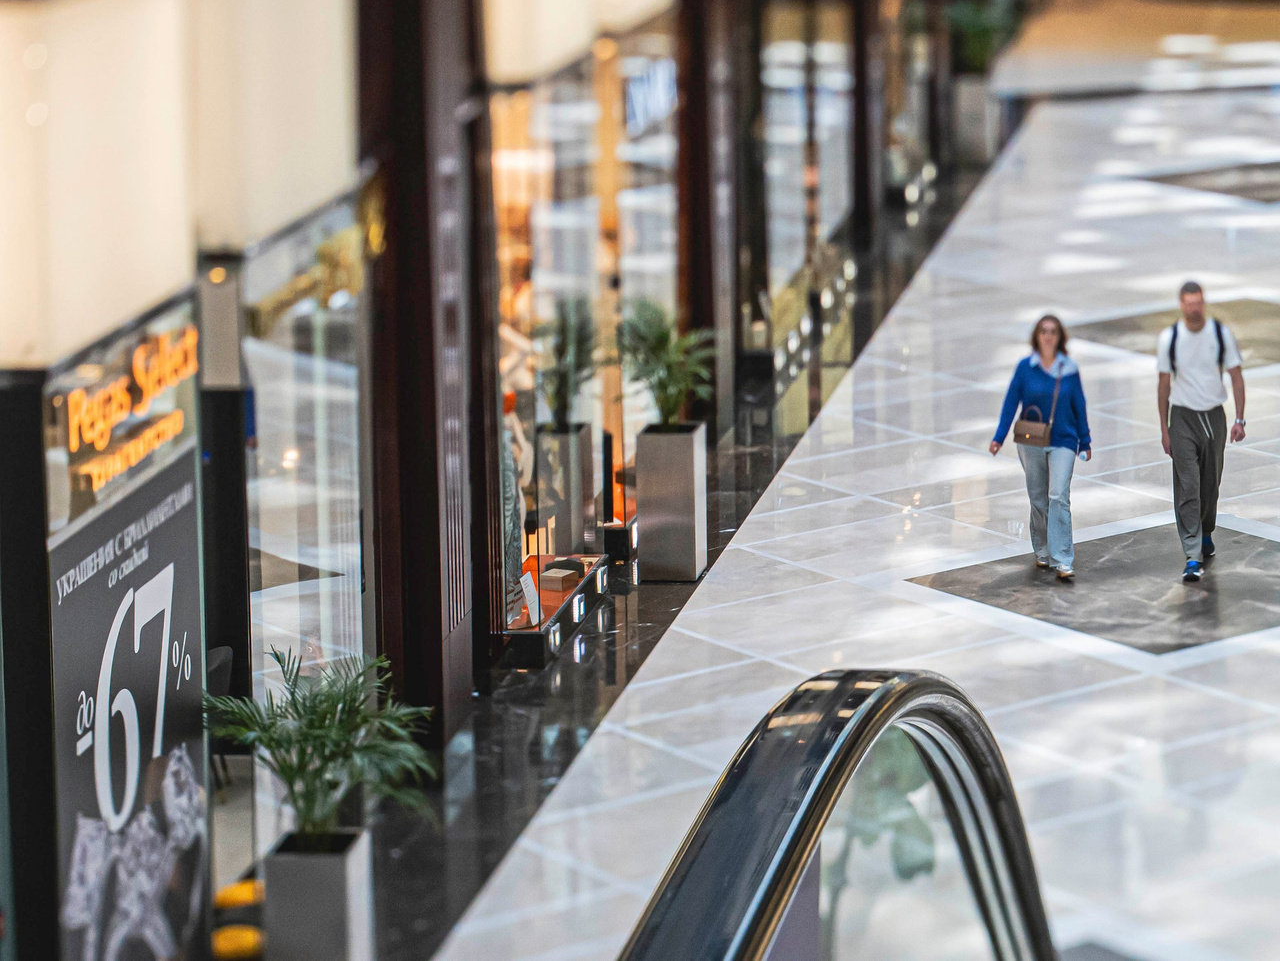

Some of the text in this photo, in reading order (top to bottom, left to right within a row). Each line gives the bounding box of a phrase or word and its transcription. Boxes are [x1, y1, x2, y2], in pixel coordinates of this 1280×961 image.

[56, 538, 115, 606] УКРАШЕНИЯ
[108, 568, 118, 588] со
[76, 691, 94, 736] до
